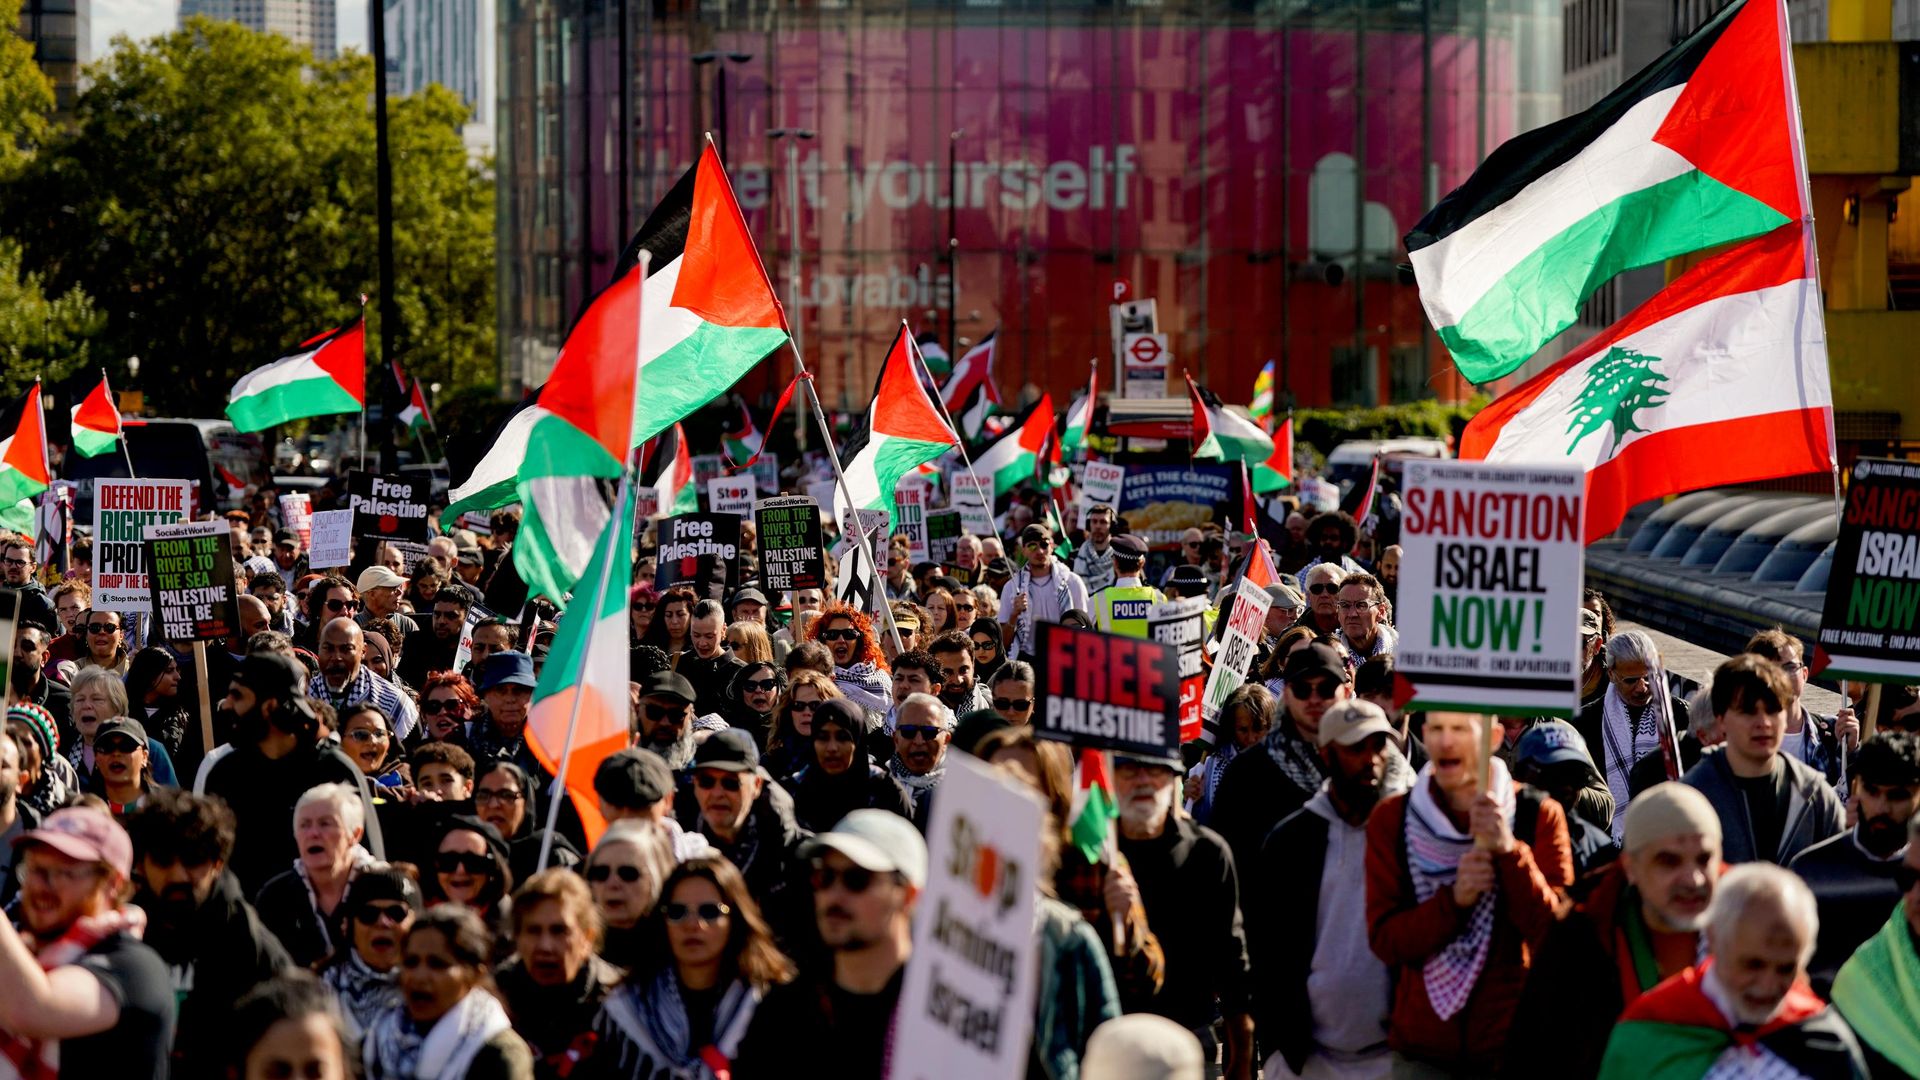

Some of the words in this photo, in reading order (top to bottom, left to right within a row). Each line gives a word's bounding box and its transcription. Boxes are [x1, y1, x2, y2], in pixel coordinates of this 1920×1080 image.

[843, 145, 1136, 224] yourself
[1114, 282, 1127, 299] P
[955, 475, 990, 486] STOP
[1087, 466, 1120, 481] STOP
[372, 477, 412, 499] Free
[905, 490, 919, 504] THE
[101, 485, 154, 511] DEFEND
[155, 486, 183, 511] THE
[350, 494, 427, 518] Palestine
[763, 498, 789, 507] Socialist
[717, 501, 752, 515] Arming
[762, 509, 789, 523] FROM
[792, 507, 812, 520] THE
[909, 505, 921, 523] TO
[1405, 486, 1580, 542] SANCTION
[155, 529, 188, 538] Socialist
[189, 526, 216, 534] Worker
[673, 519, 713, 540] Free
[763, 522, 791, 536] RIVER
[793, 521, 807, 534] TO
[153, 541, 191, 557] FROM
[194, 537, 219, 553] THE
[659, 538, 736, 564] Palestine
[763, 536, 783, 549] THE
[785, 535, 804, 548] SEA
[156, 555, 192, 573] RIVER
[196, 554, 214, 570] TO
[765, 547, 817, 563] PALESTINE
[766, 562, 791, 576] WILL
[792, 561, 806, 574] BE
[1434, 543, 1547, 593] ISRAEL
[100, 574, 123, 588] DROP
[125, 575, 140, 588] THE
[158, 574, 182, 590] THE
[187, 571, 210, 587] SEA
[767, 575, 792, 589] FREE
[111, 595, 127, 603] Stop
[160, 585, 227, 606] PALESTINE
[161, 604, 192, 622] WILL
[195, 604, 213, 621] BE
[164, 622, 195, 639] FREE
[1431, 594, 1543, 652] NOW!
[1820, 629, 1839, 643] FREE
[1841, 631, 1883, 648] PALESTINE
[1889, 635, 1905, 649] END
[1047, 626, 1166, 713] FREE
[1046, 694, 1166, 746] PALESTINE
[932, 893, 1015, 999] Arming
[927, 961, 1005, 1057] Israel
